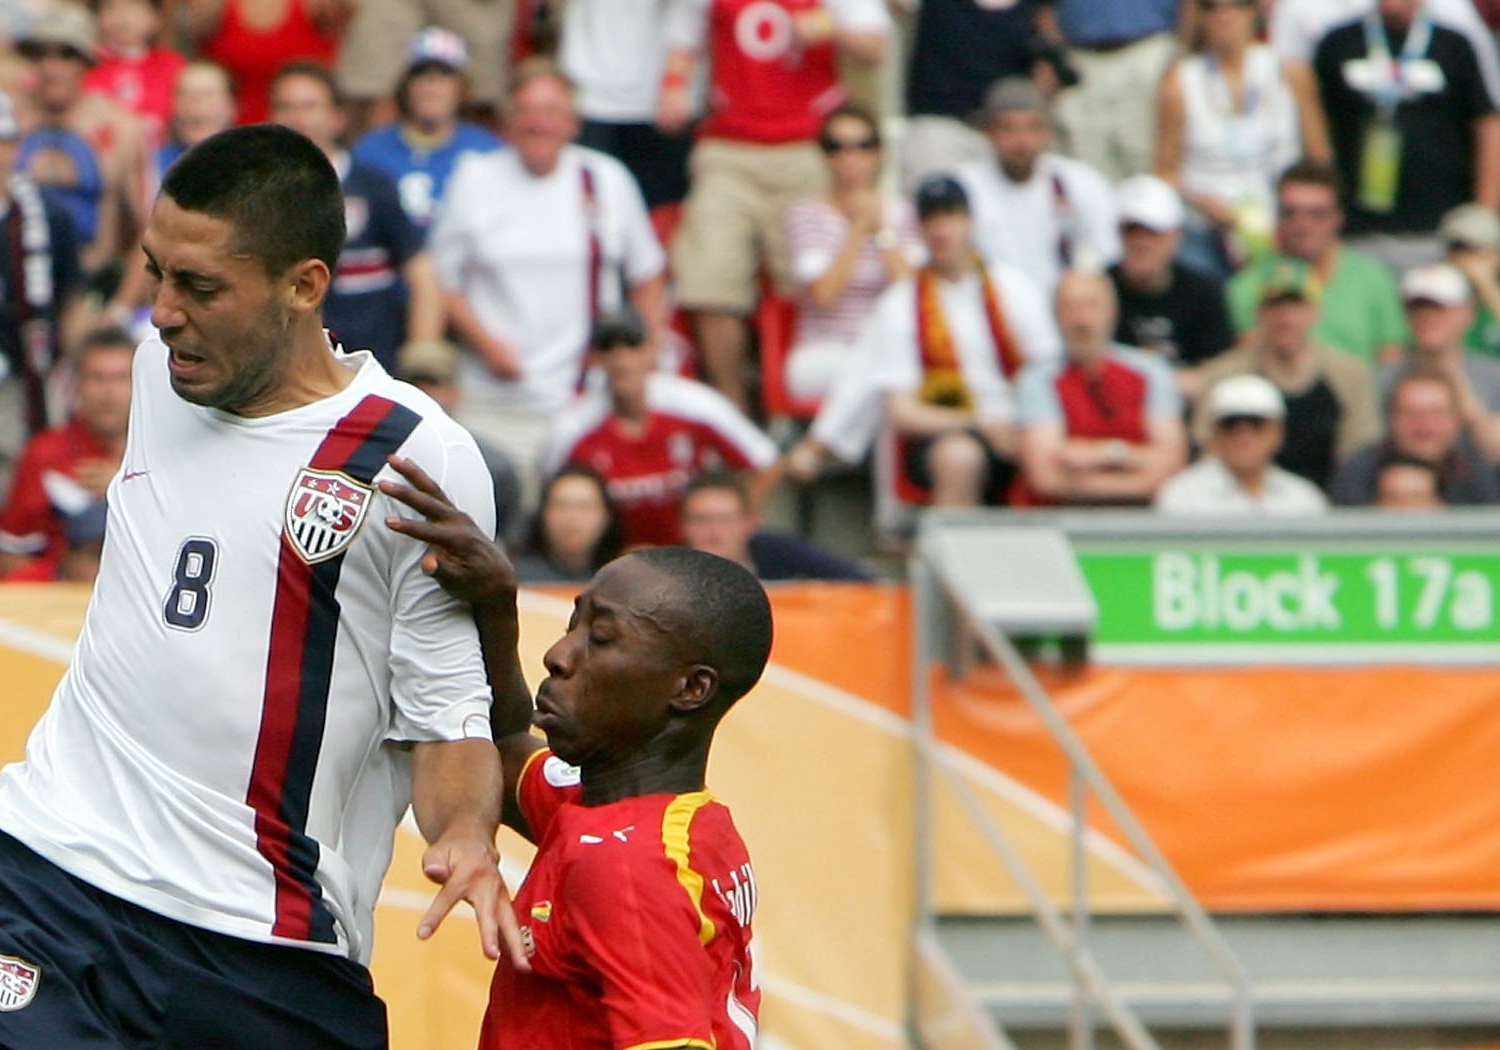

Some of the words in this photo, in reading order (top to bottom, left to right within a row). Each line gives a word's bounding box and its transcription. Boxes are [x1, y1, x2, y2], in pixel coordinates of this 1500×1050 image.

[162, 536, 220, 633] 8
[1153, 551, 1343, 632] Block
[1364, 556, 1493, 632] 17a
